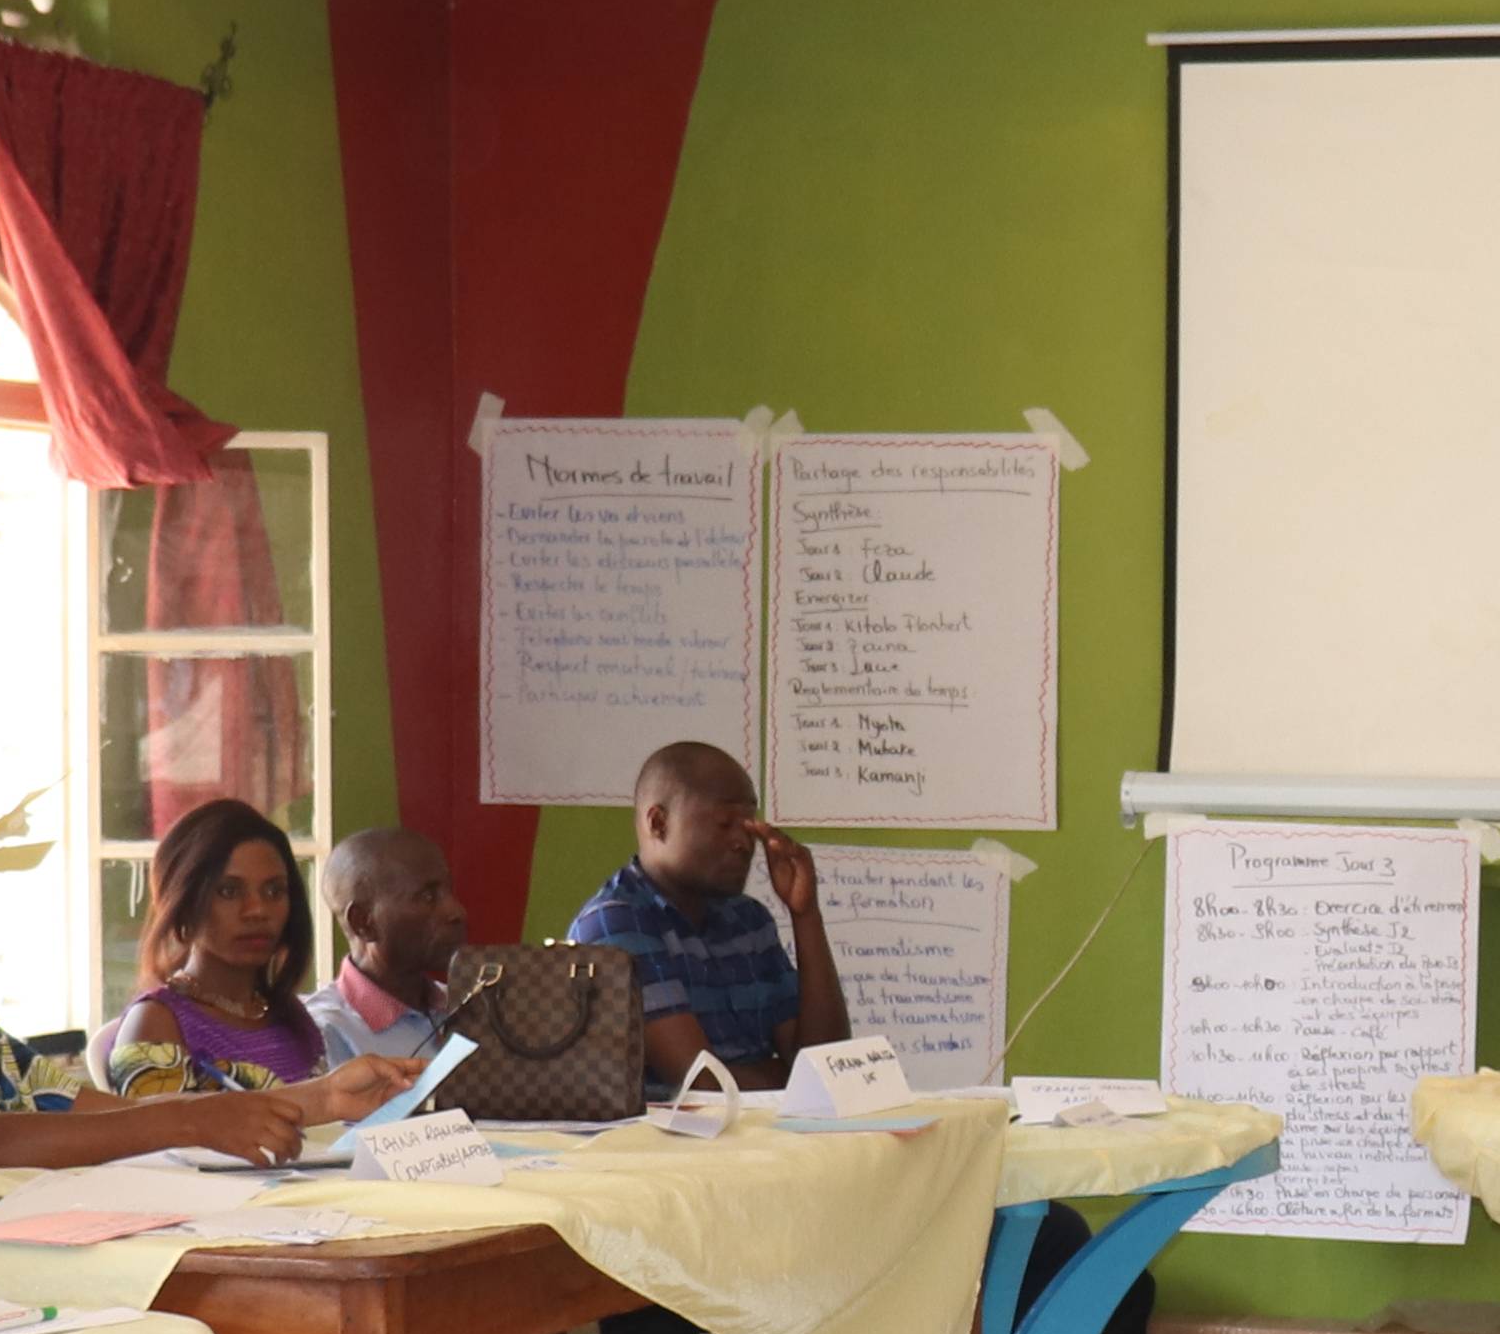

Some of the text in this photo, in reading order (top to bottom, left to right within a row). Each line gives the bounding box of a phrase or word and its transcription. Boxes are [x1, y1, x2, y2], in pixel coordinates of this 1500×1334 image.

[630, 460, 650, 484] de
[659, 454, 733, 487] travail
[862, 560, 936, 584] Claude
[1227, 842, 1397, 881] Programme Jour 3
